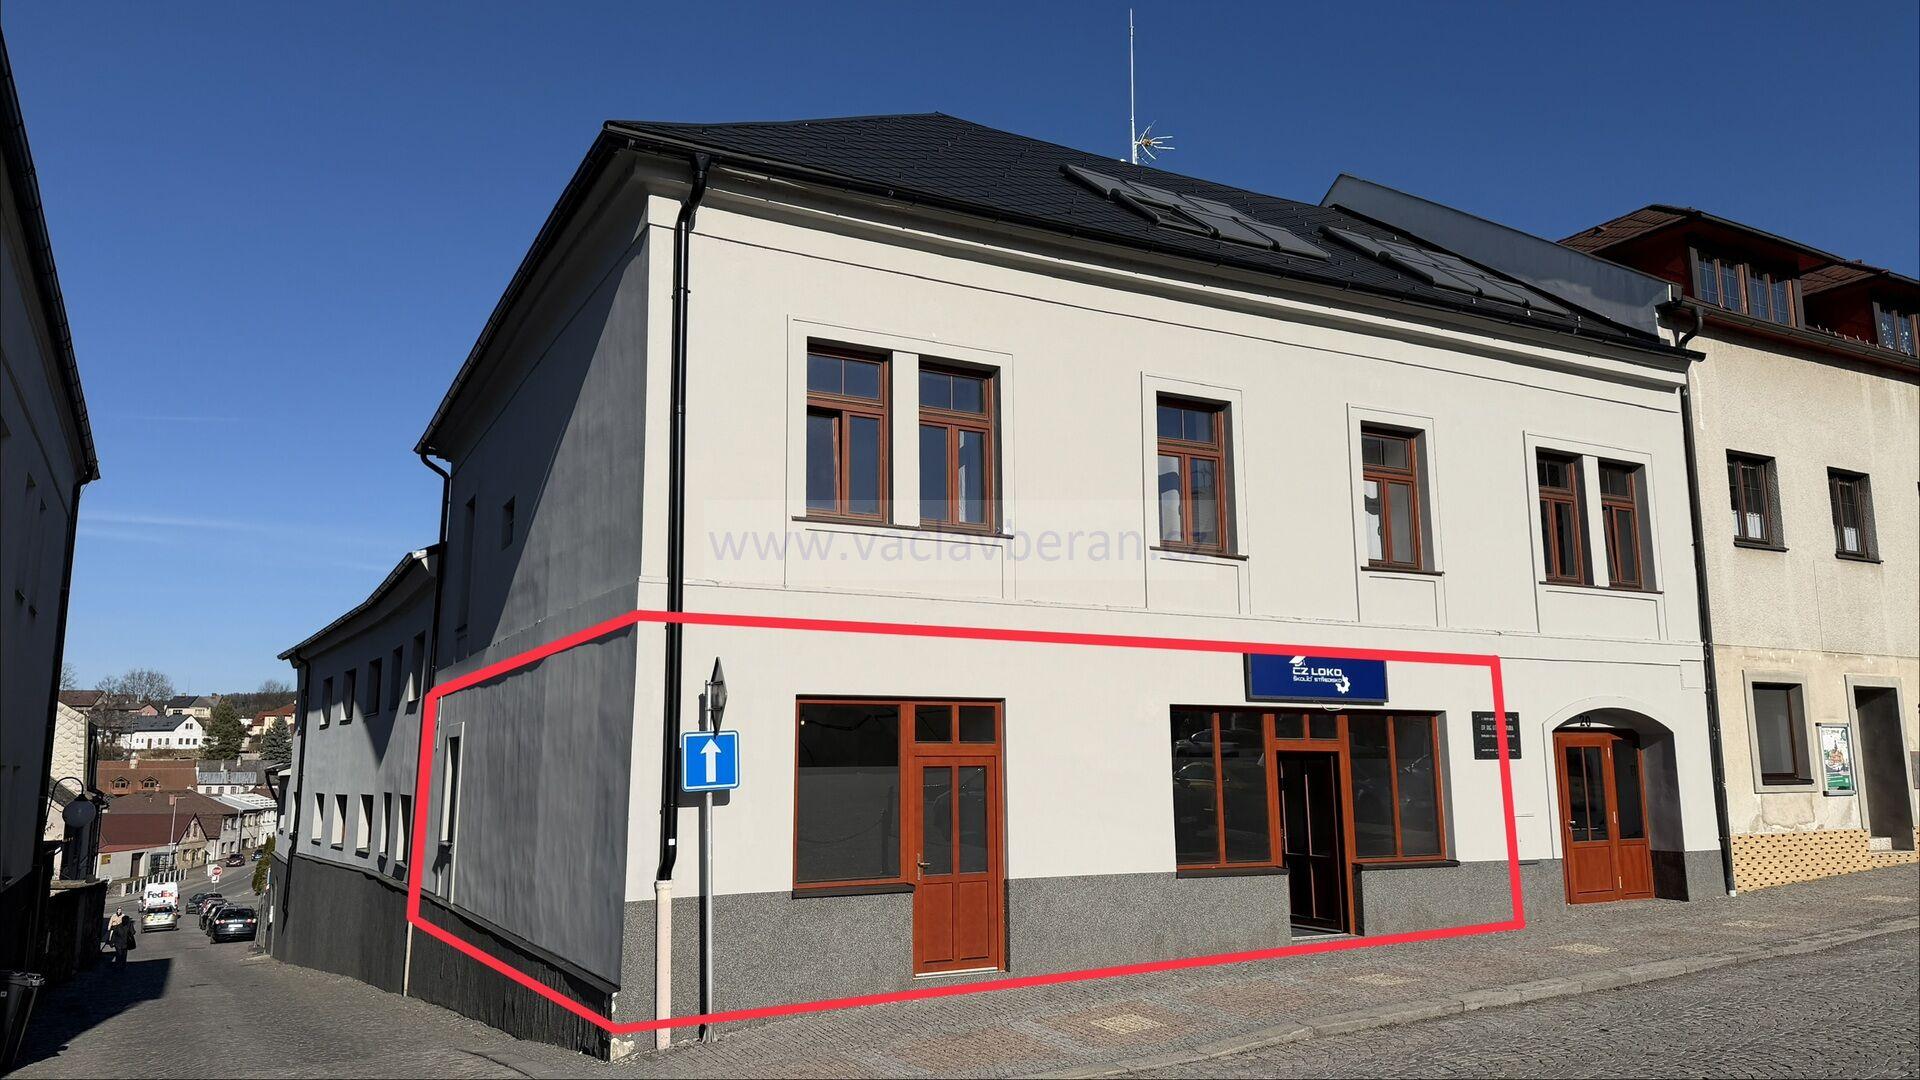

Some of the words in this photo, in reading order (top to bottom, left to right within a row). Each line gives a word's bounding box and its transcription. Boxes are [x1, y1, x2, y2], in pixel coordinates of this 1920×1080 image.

[1292, 667, 1309, 675] CZ
[1311, 668, 1342, 676] LOKO
[1579, 715, 1591, 727] 20
[147, 890, 174, 898] FedEx
